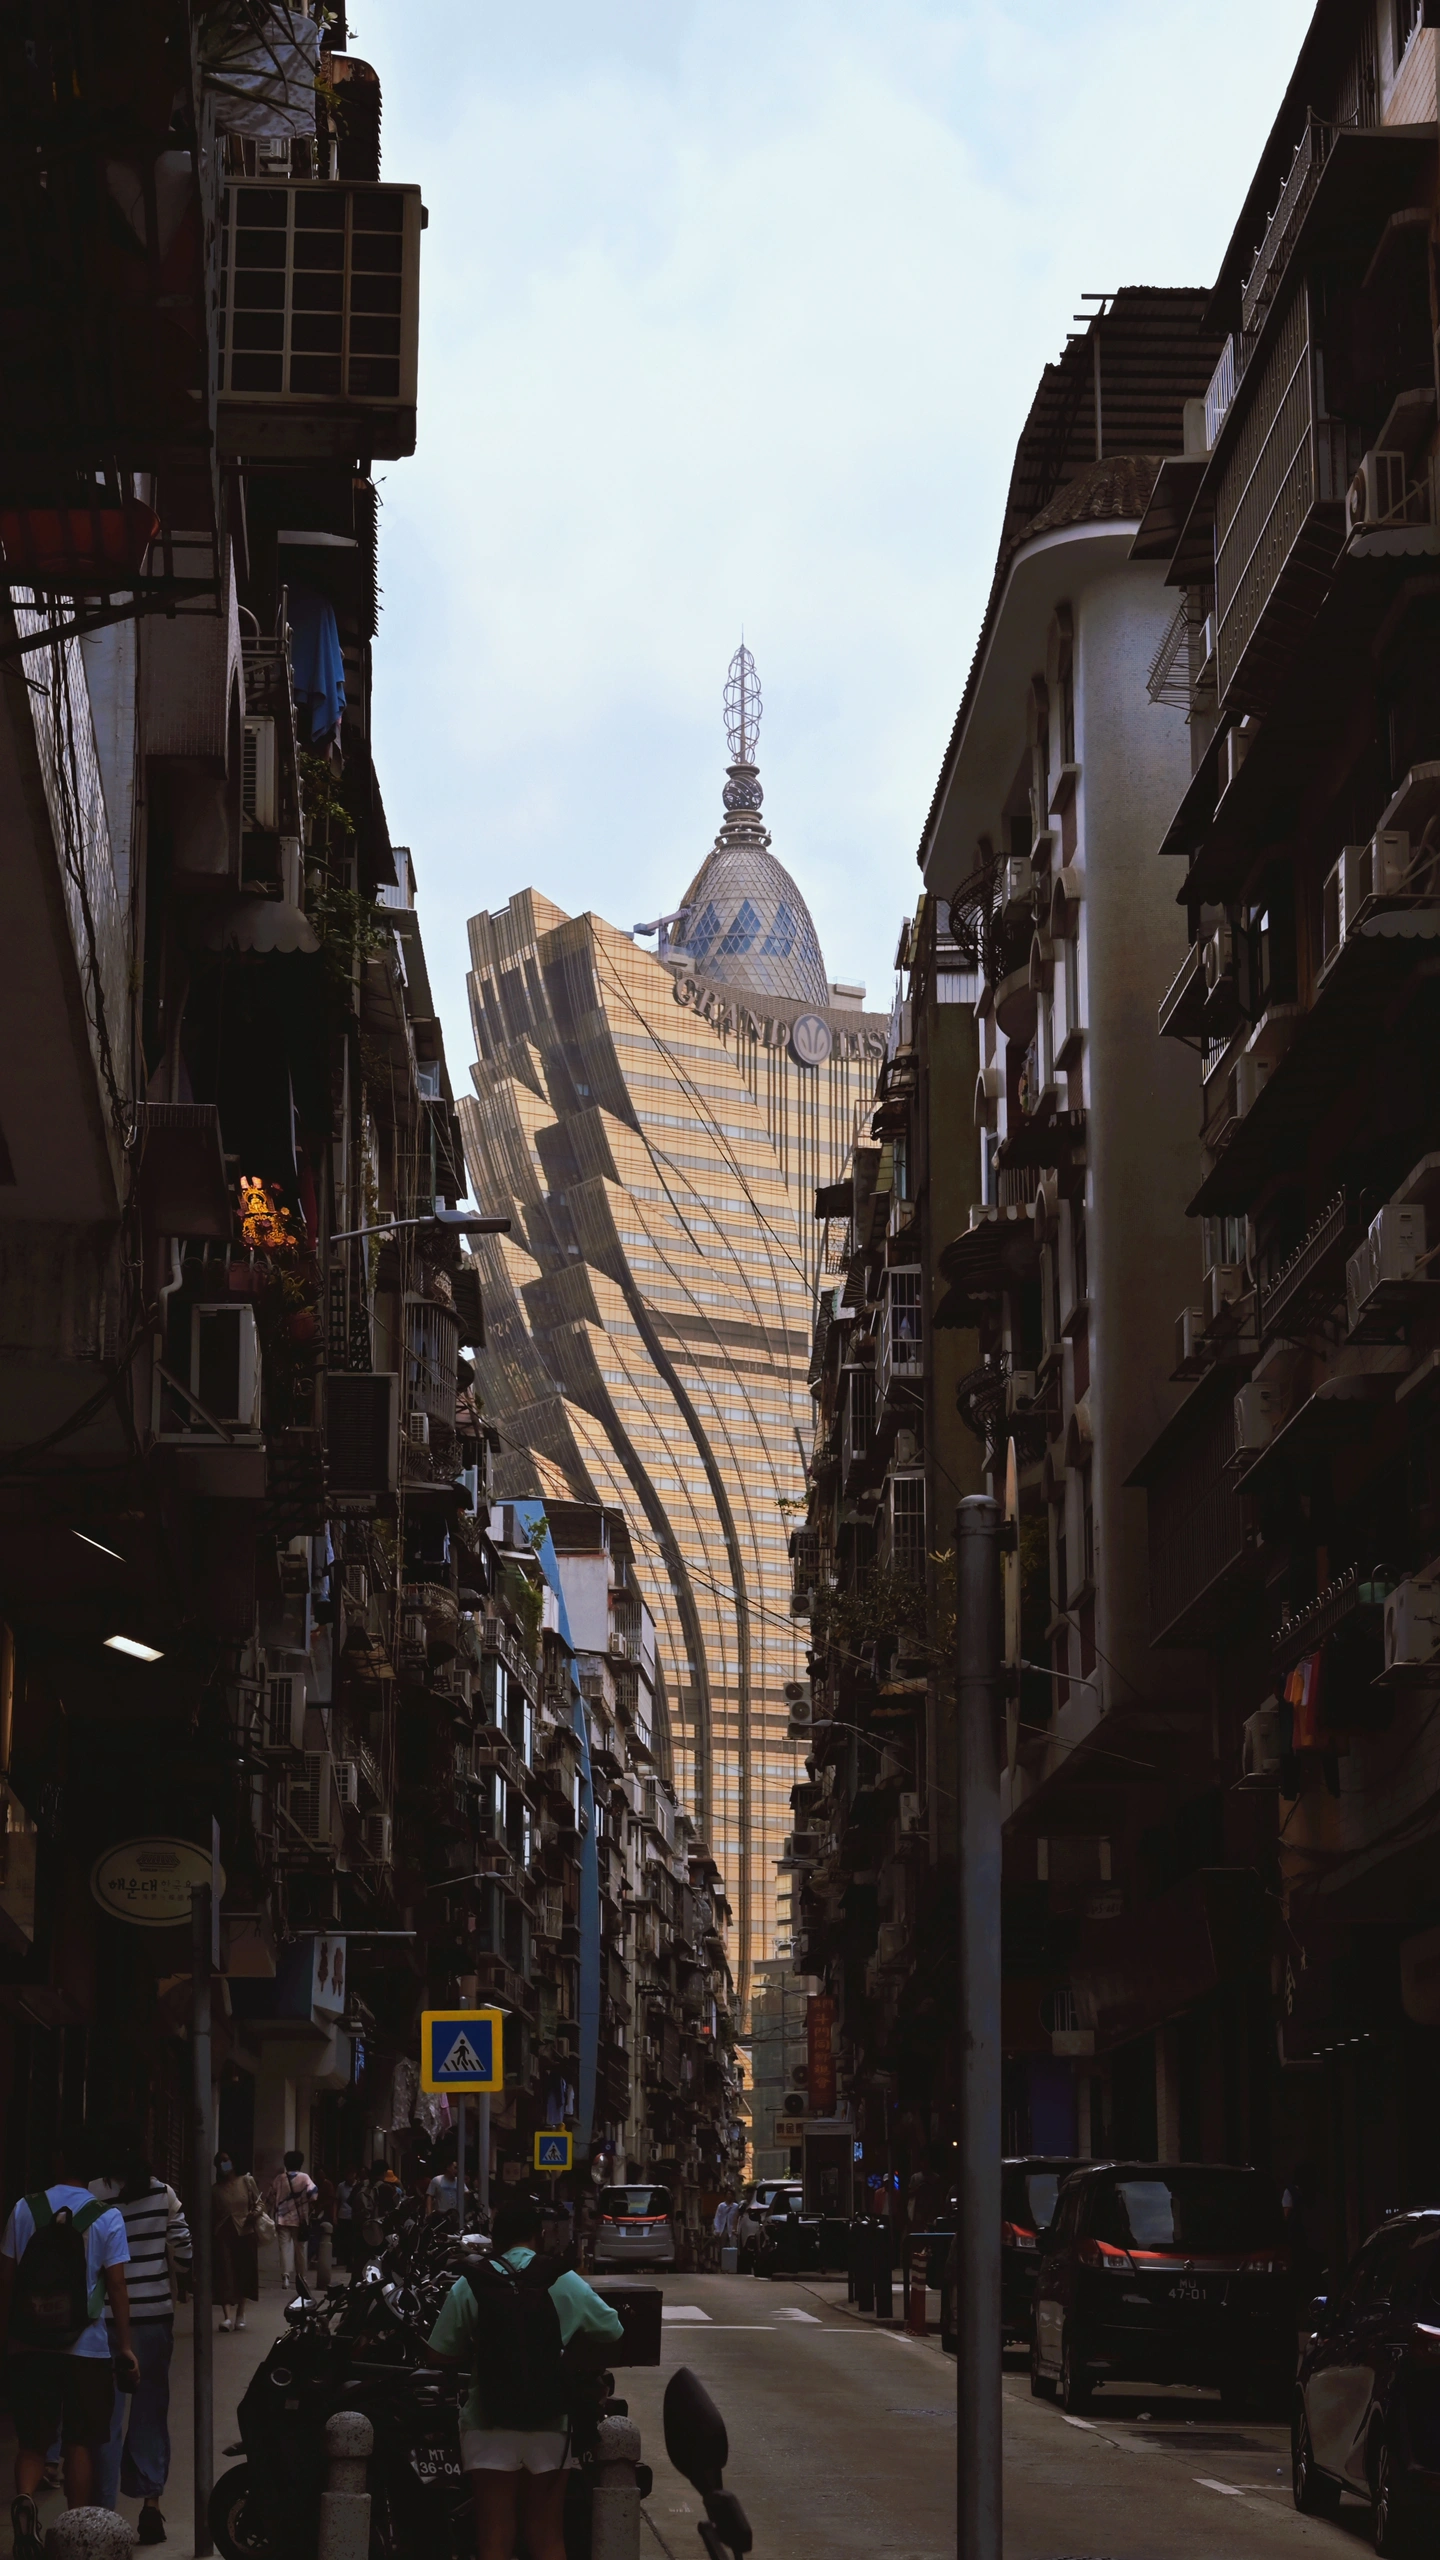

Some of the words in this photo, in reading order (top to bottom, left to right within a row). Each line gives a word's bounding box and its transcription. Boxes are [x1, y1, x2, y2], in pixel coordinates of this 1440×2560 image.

[672, 976, 791, 1047] GRAND
[838, 1028, 888, 1060] LIS
[108, 1877, 157, 1900] 해운대
[160, 1879, 192, 1893] 한국요
[1179, 2278, 1197, 2289] MU
[1168, 2287, 1207, 2300] 47-01
[428, 2449, 445, 2461] MT
[419, 2461, 461, 2476] 36-04
